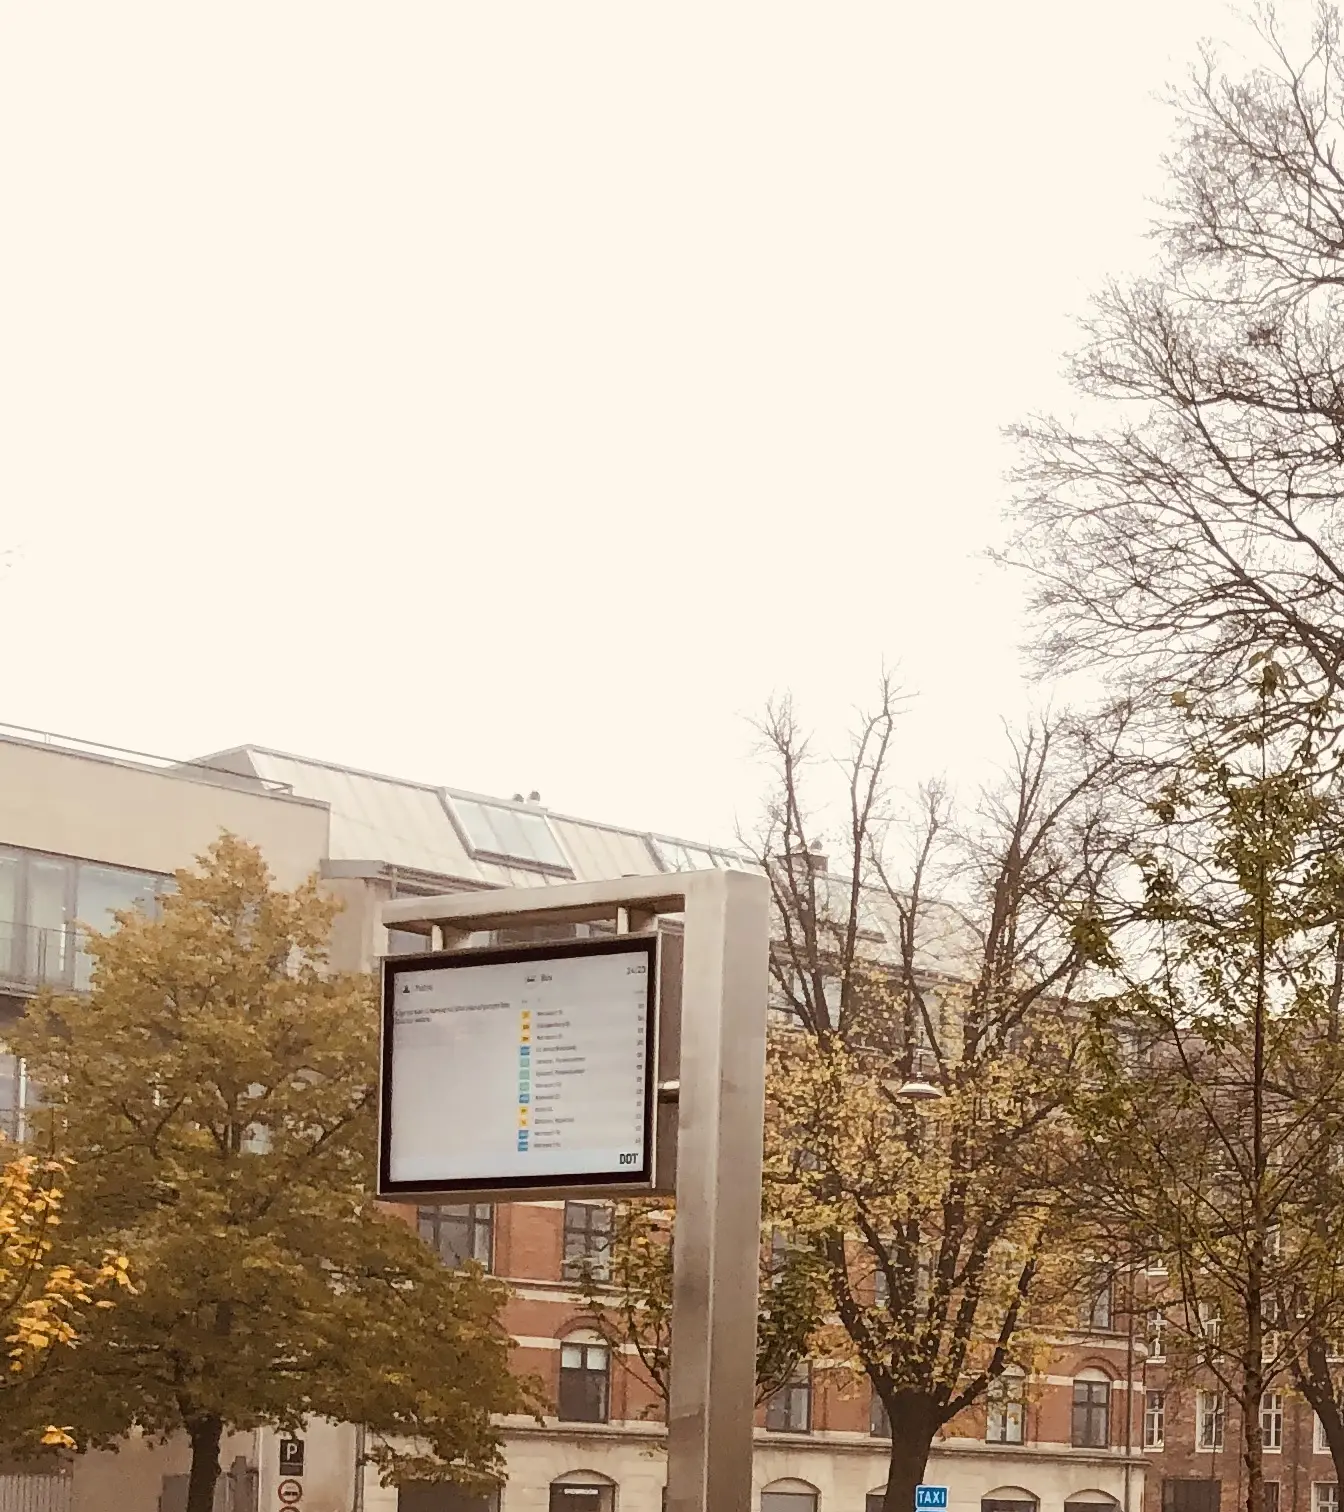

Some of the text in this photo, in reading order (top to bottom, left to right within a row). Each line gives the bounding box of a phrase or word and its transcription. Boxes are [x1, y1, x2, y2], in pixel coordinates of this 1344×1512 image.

[619, 1153, 639, 1165] DOT
[286, 1442, 298, 1461] P
[918, 1490, 945, 1504] TAXI
